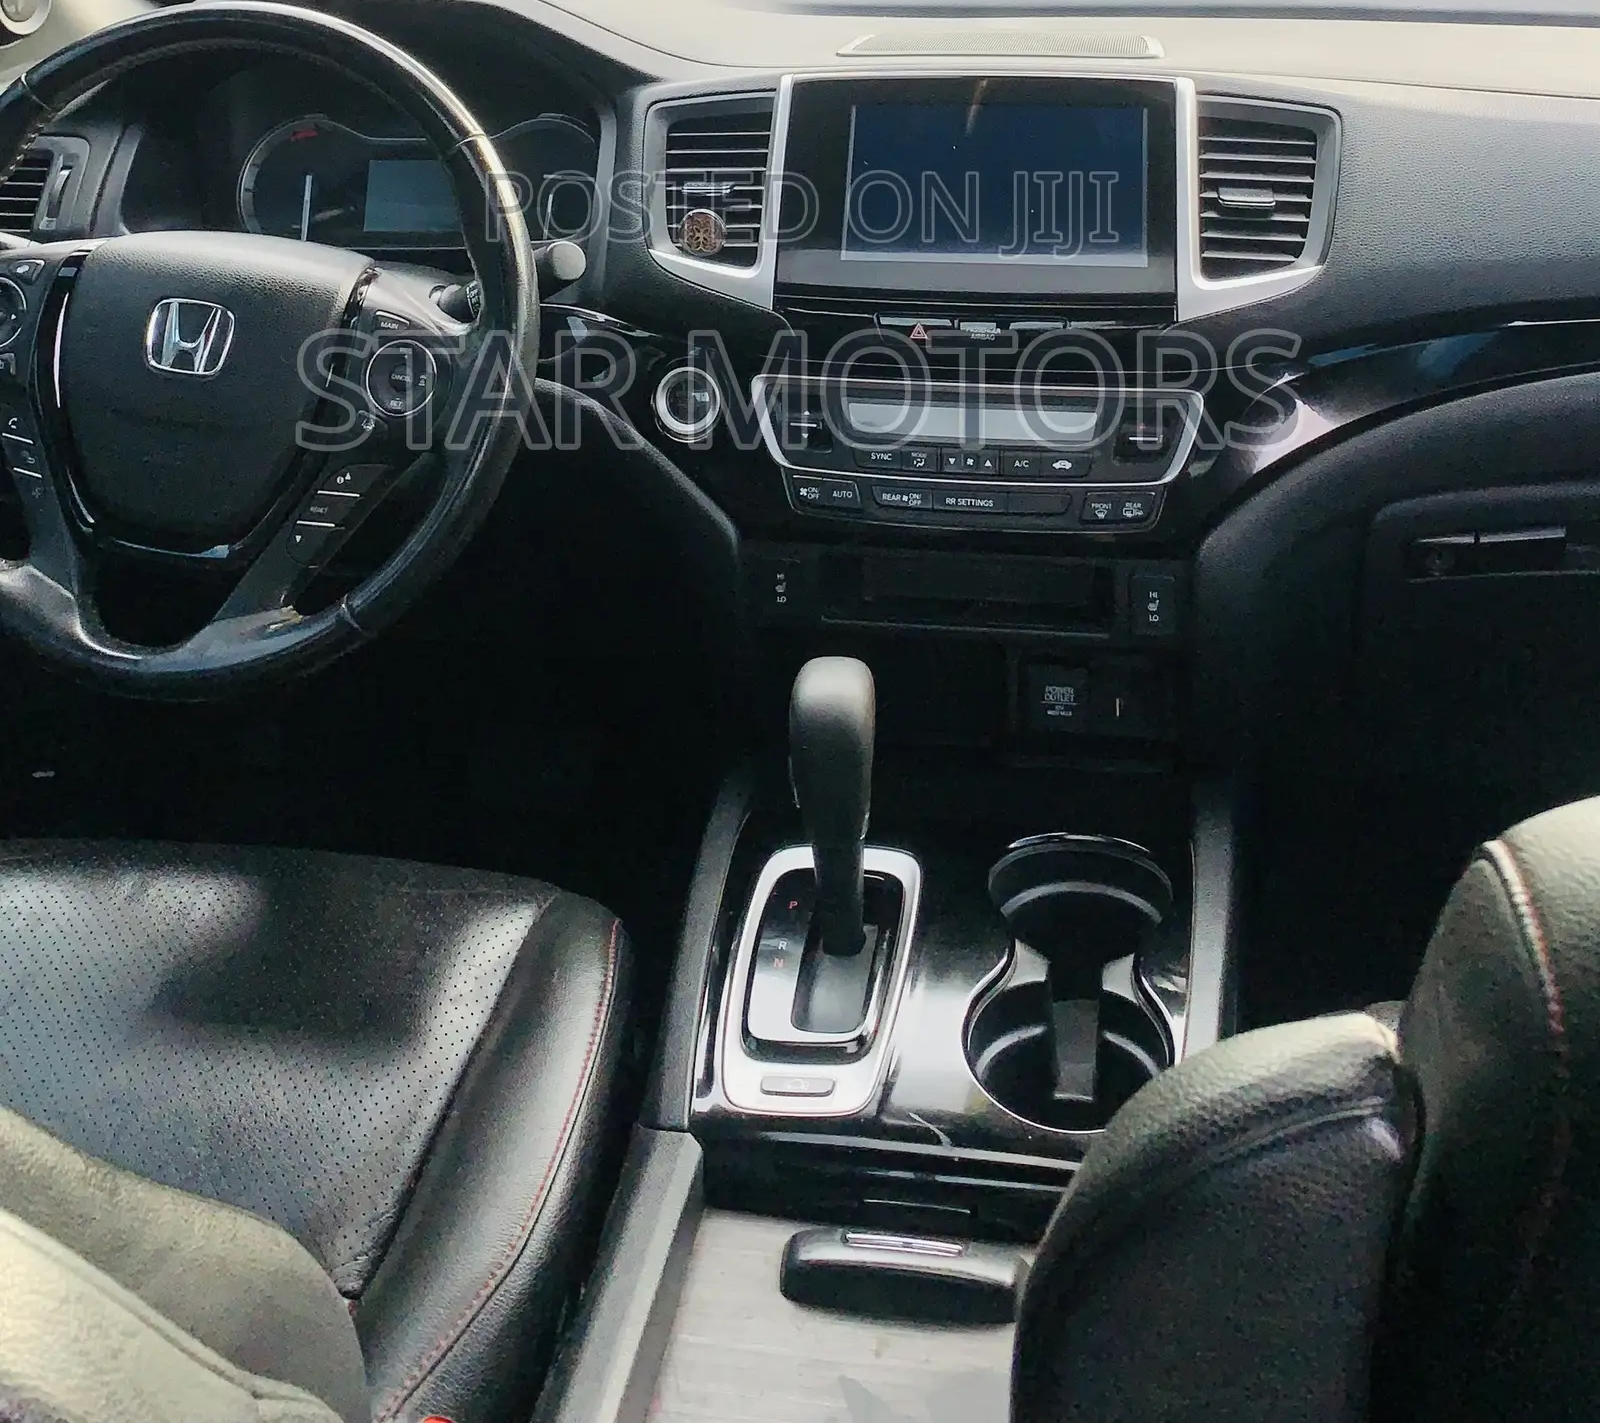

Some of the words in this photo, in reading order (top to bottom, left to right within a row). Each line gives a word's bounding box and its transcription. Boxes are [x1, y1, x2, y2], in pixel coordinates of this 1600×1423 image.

[870, 452, 893, 462] SYNC
[1014, 458, 1030, 469] A/C
[807, 492, 820, 500] OFF
[832, 490, 853, 499] AUTO
[882, 493, 901, 502] REAR
[945, 497, 956, 507] RR
[957, 497, 995, 508] SETTINGS
[789, 901, 797, 909] P
[778, 940, 787, 950] R
[773, 958, 784, 968] N
